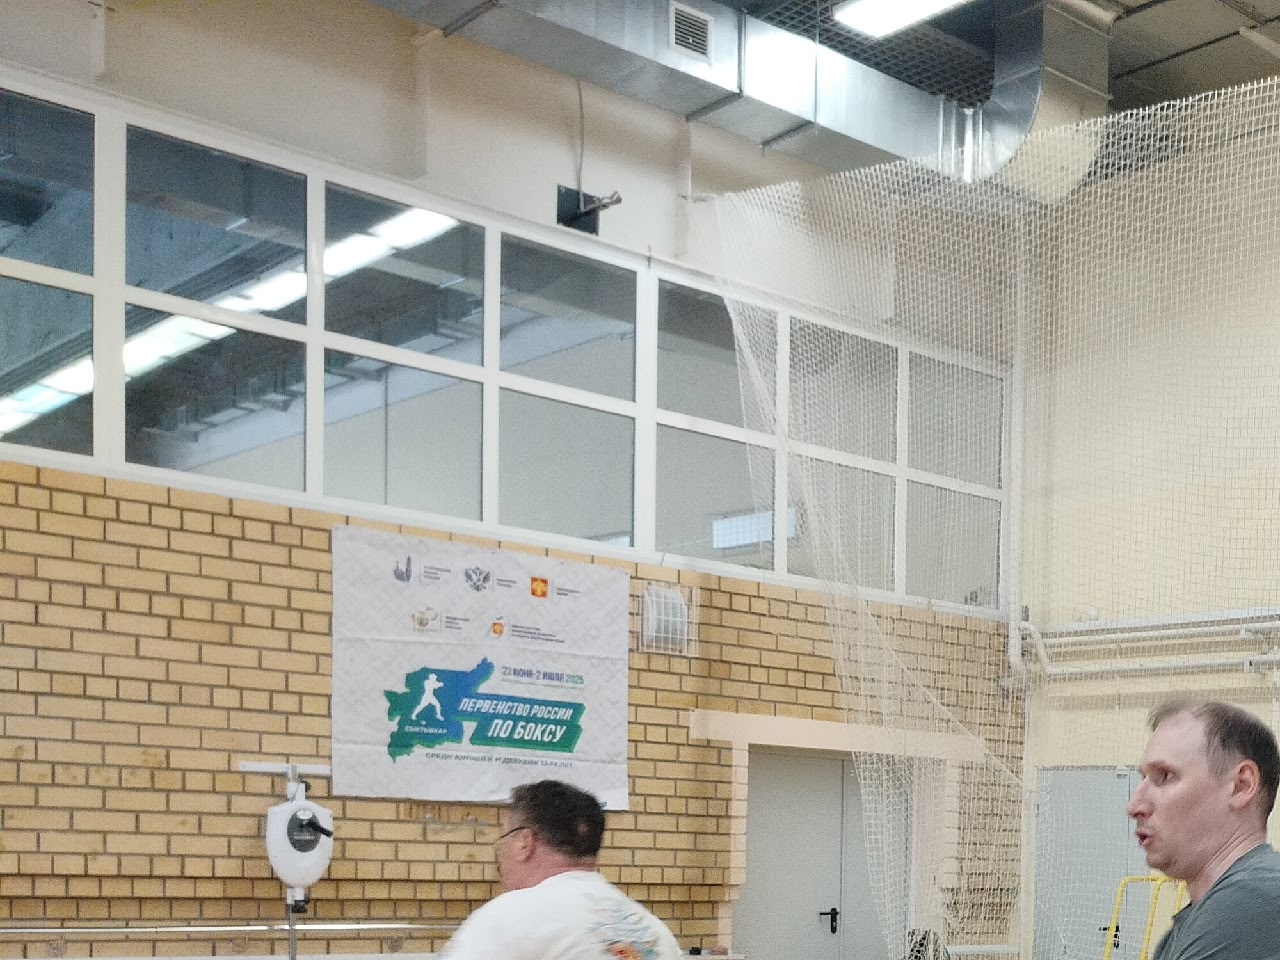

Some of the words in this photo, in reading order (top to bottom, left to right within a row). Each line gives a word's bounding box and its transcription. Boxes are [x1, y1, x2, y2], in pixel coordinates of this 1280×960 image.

[459, 698, 530, 718] ПЕРВЕНСТВО
[530, 704, 574, 721] РОССИИ
[487, 718, 514, 739] ПО
[513, 721, 567, 743] БОКСУ
